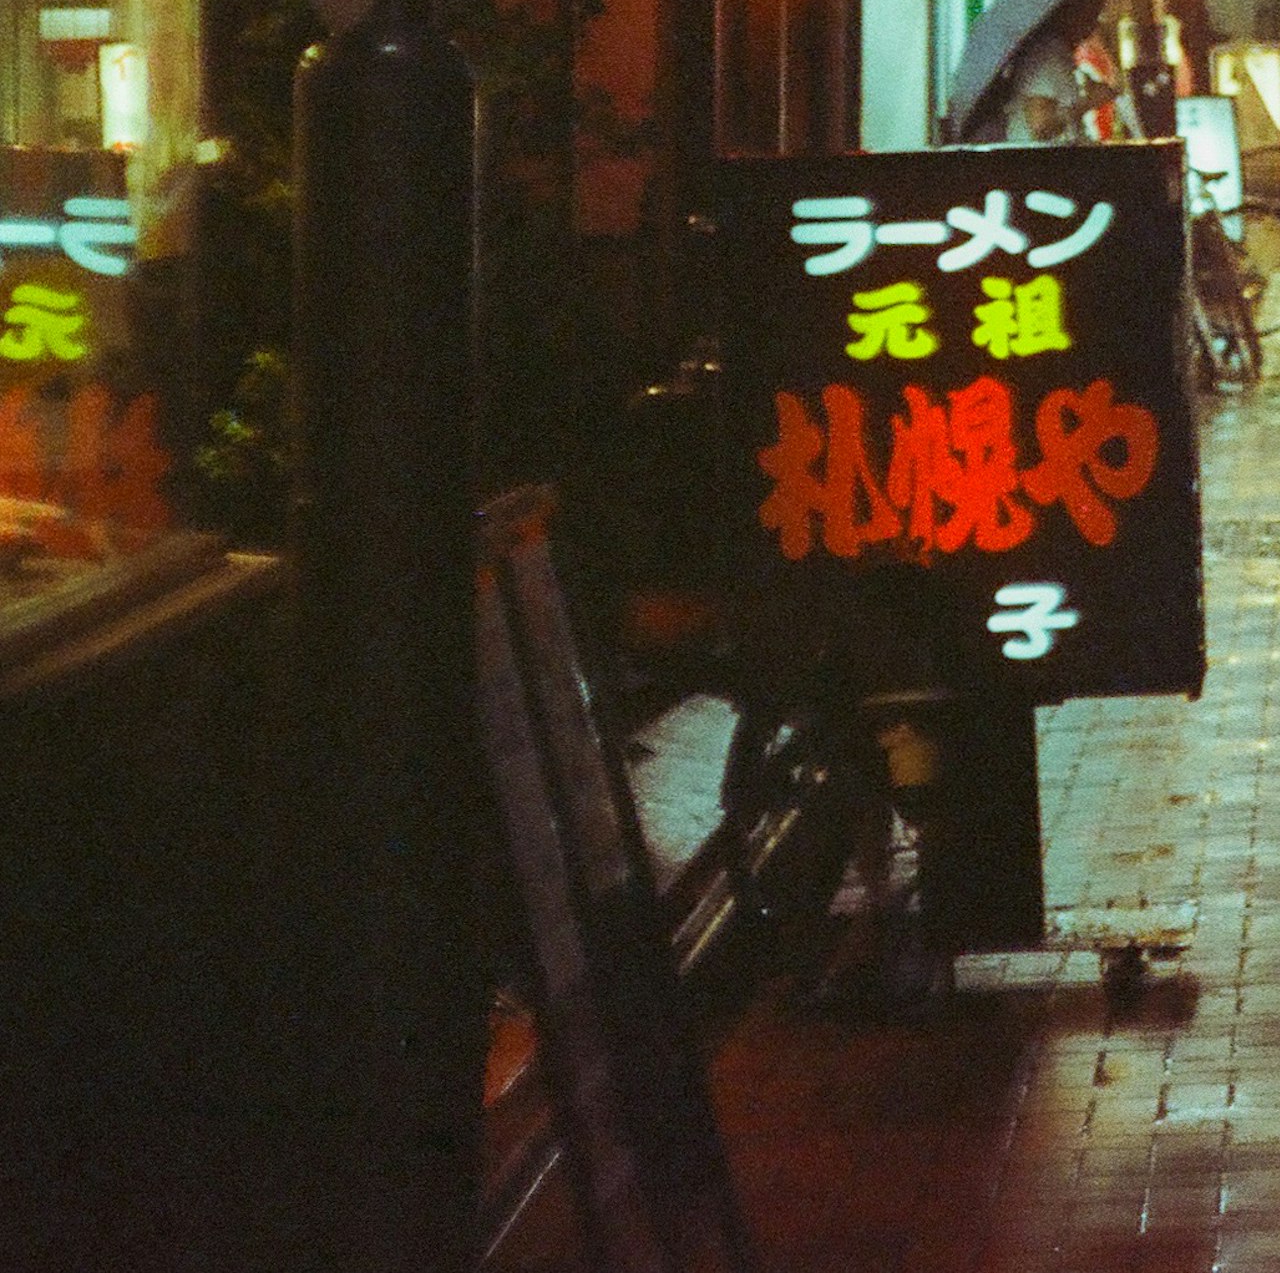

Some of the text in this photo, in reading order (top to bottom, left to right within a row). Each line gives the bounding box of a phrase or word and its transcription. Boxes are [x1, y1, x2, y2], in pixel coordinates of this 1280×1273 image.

[791, 189, 1114, 276] ラーメン
[846, 274, 1072, 361] 元祖
